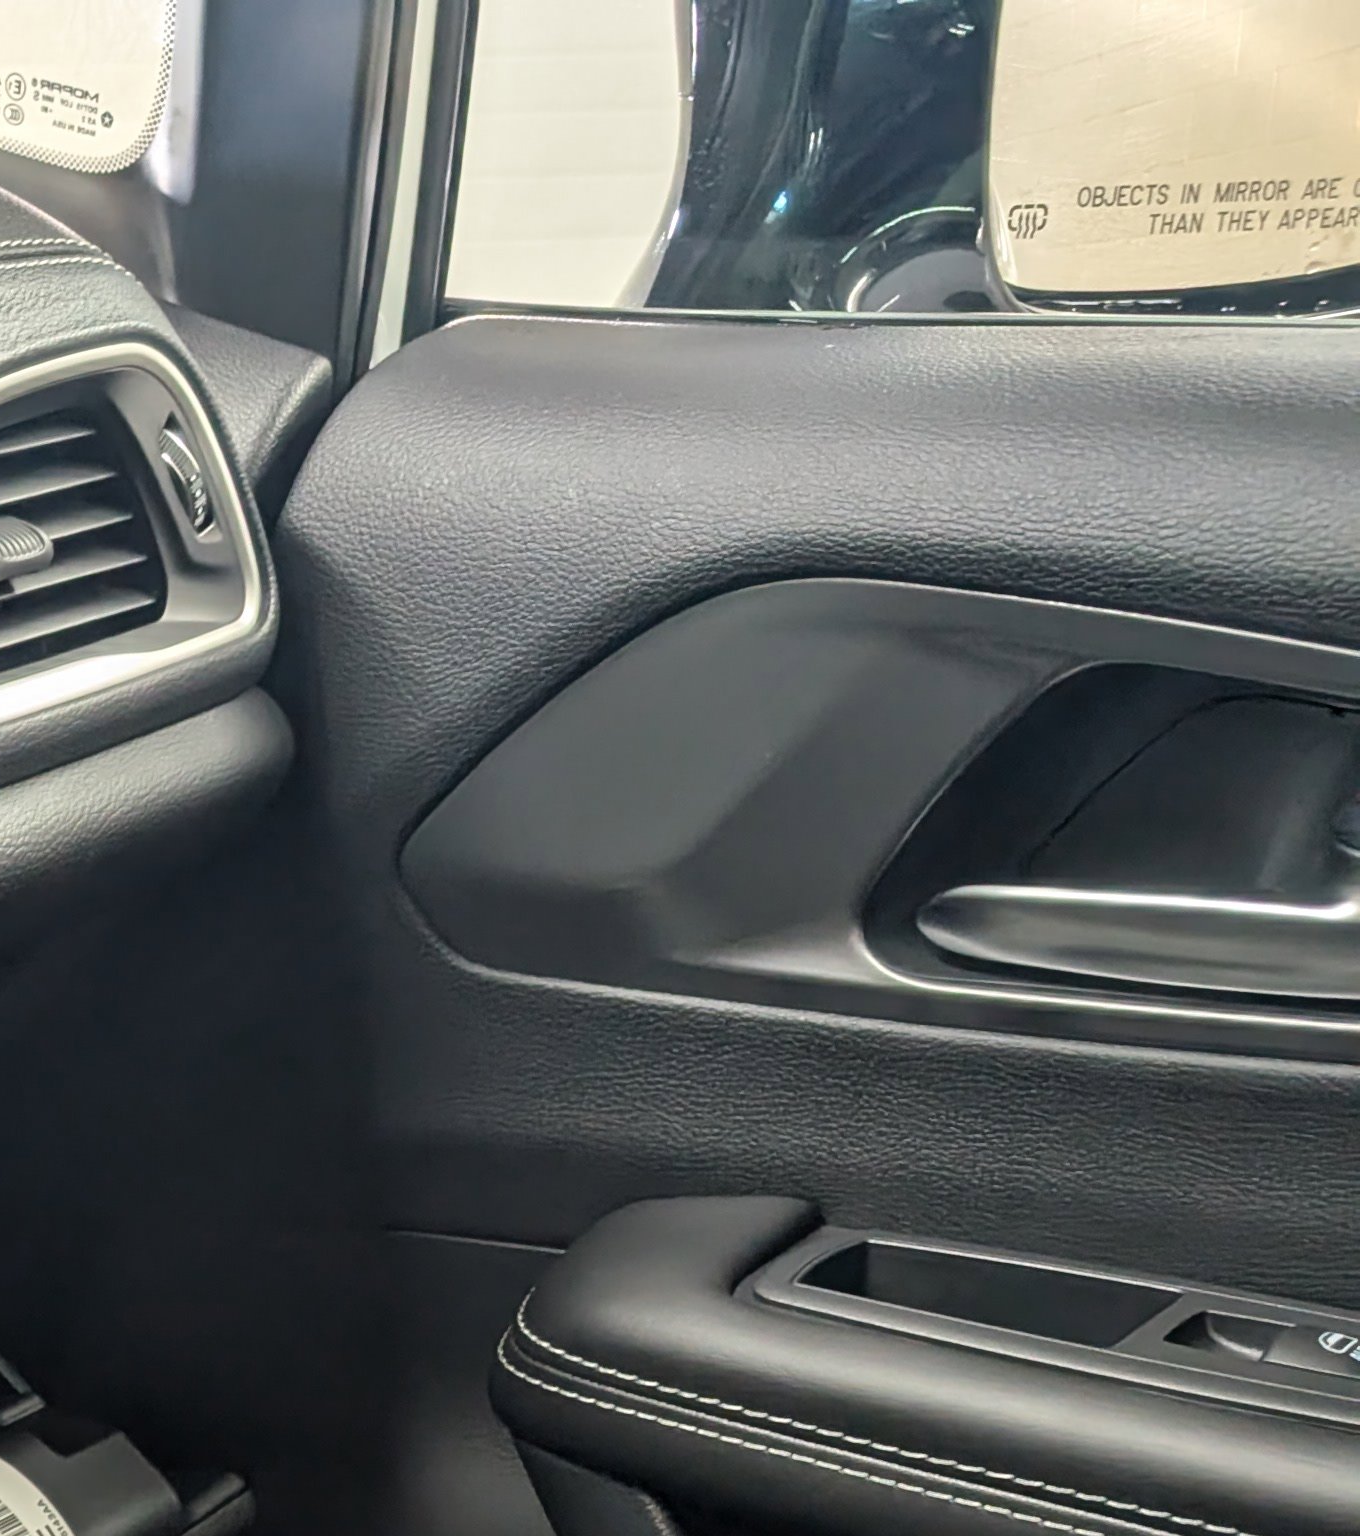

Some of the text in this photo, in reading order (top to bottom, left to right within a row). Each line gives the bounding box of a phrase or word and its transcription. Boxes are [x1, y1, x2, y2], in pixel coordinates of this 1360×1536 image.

[1076, 183, 1170, 208] OBJECTS
[1179, 182, 1204, 205] IN
[1213, 179, 1291, 203] MIRROR
[1300, 176, 1345, 200] ARE
[1148, 205, 1360, 236] THAN THEY APPEAR
